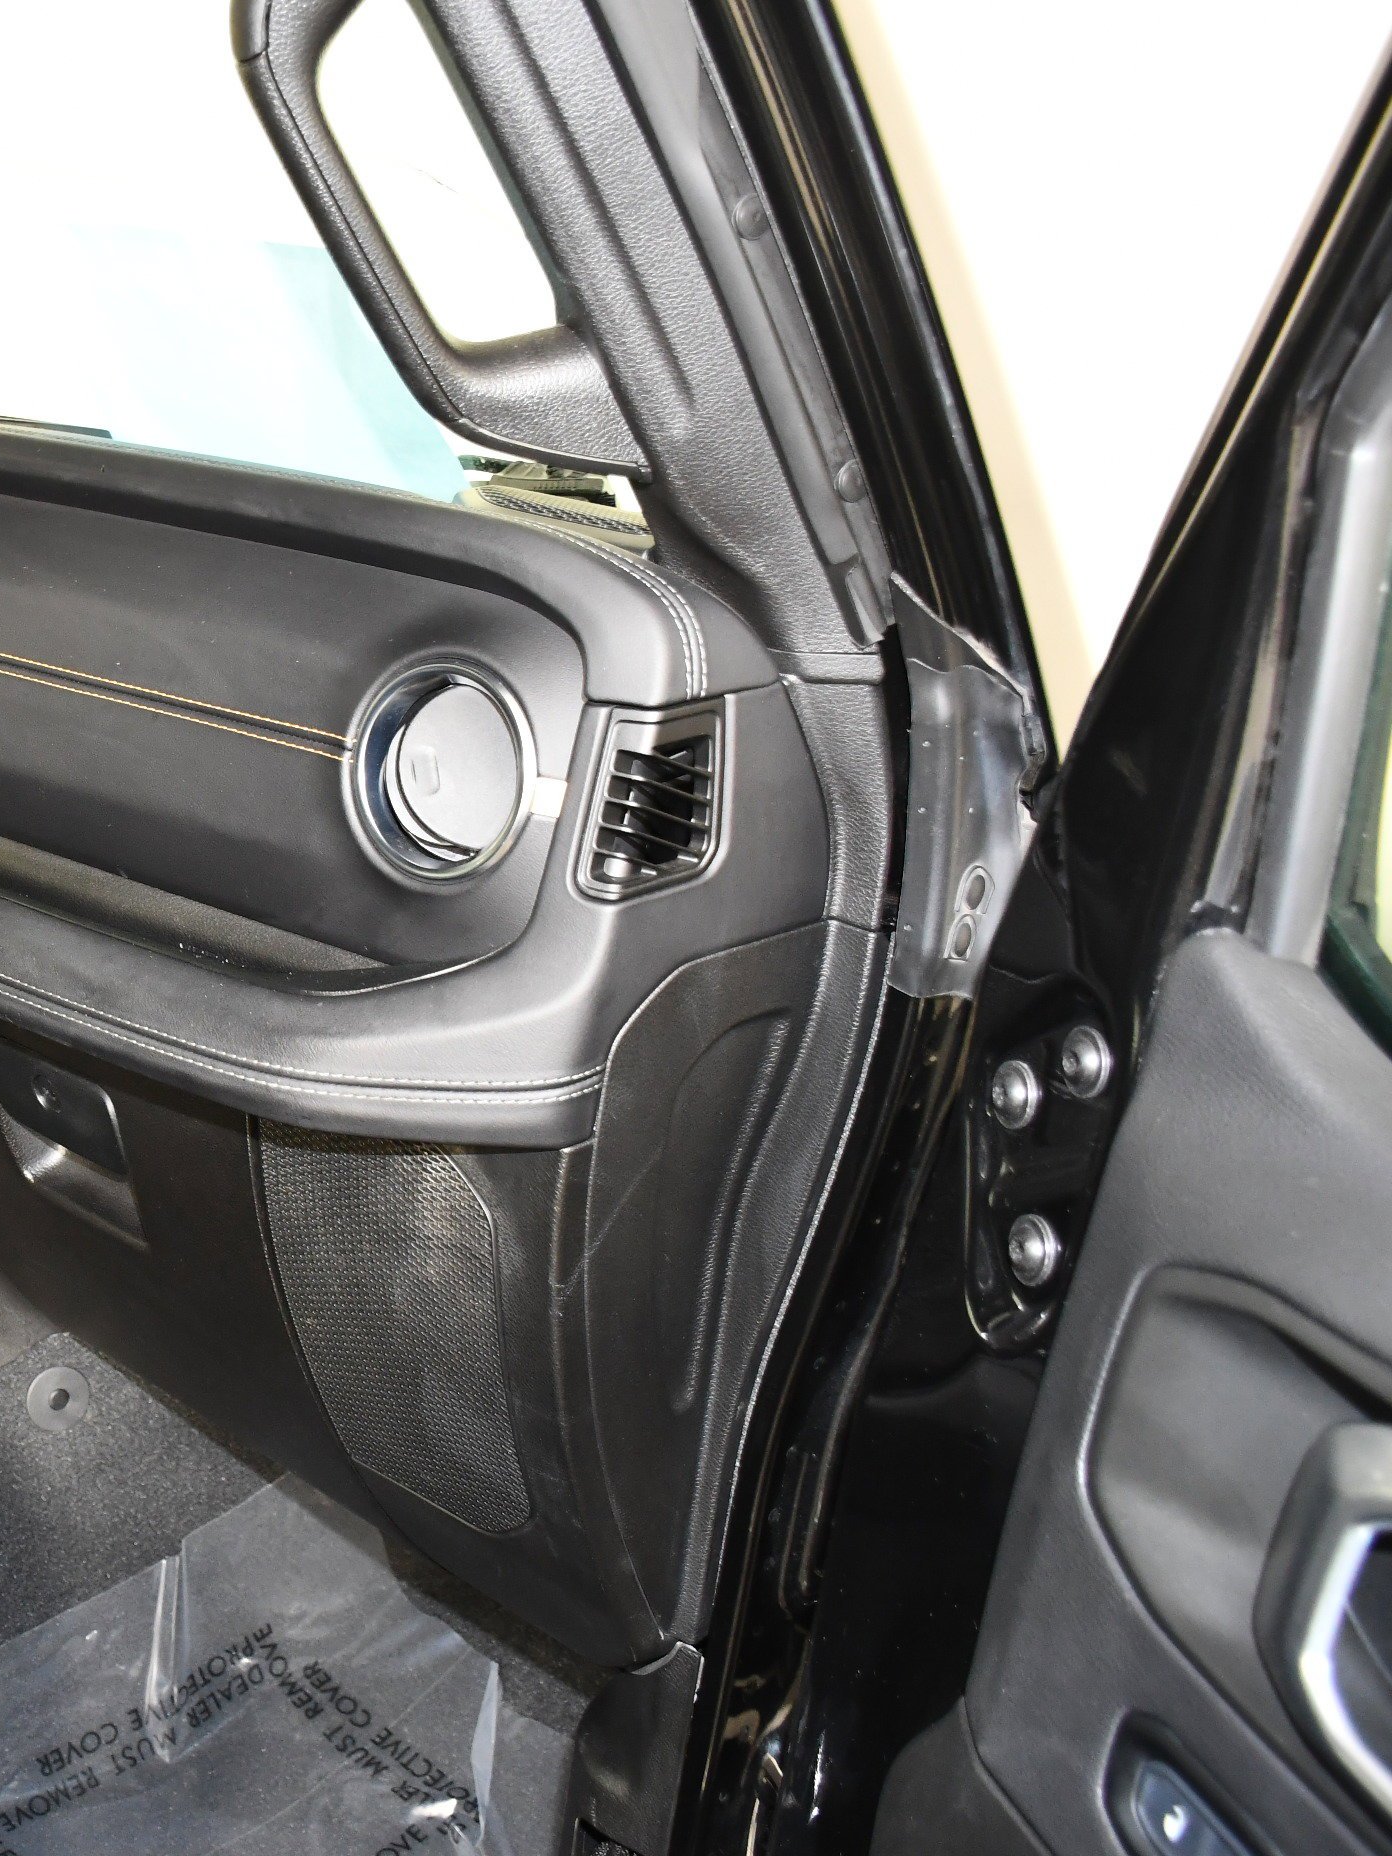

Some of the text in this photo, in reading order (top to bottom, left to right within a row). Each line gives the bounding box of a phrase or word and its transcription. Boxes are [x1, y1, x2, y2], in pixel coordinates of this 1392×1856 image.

[35, 1635, 257, 1778] PROTECTIVE COVER
[186, 1662, 264, 1729] DEALER
[302, 1659, 373, 1729] COVER
[109, 1726, 178, 1777] MUST
[252, 1622, 467, 1845] DELER MUST REMOVE
